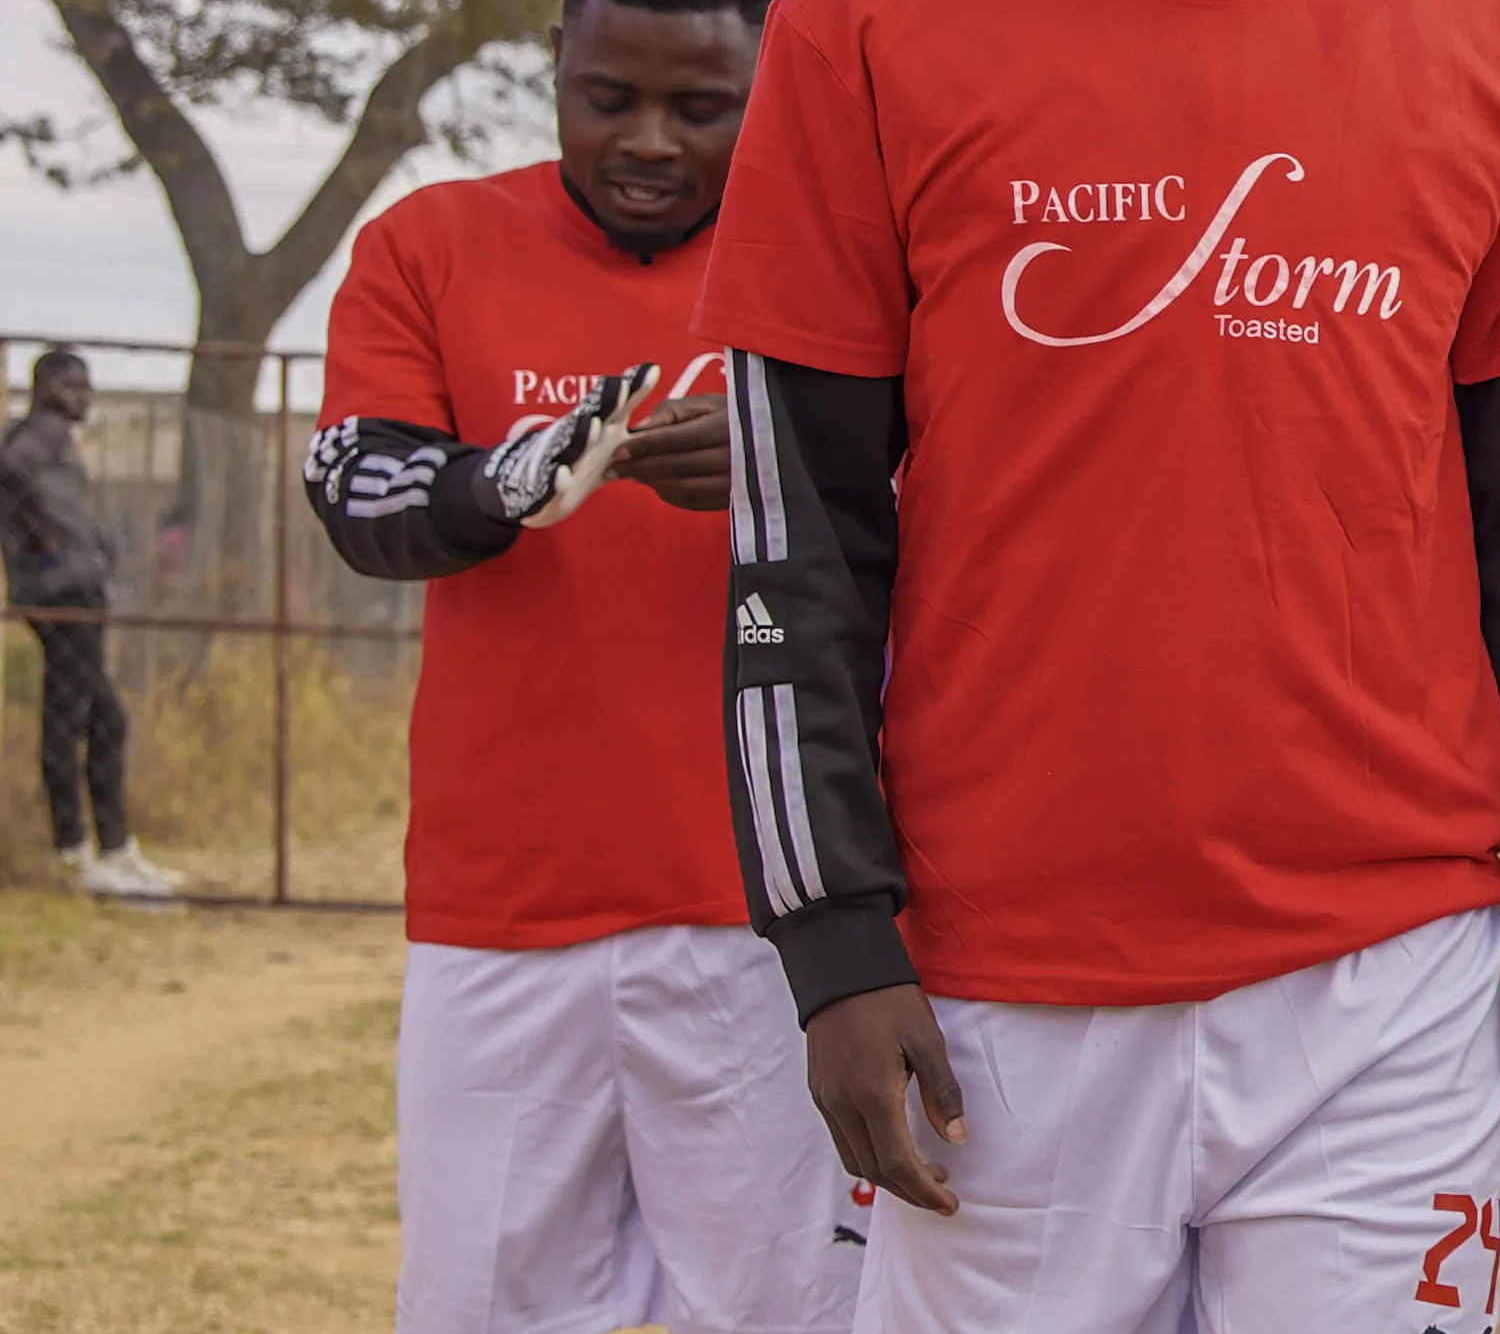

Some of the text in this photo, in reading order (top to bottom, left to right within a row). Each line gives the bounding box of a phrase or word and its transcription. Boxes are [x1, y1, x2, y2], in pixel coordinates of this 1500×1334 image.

[1009, 175, 1186, 224] PACIFIC
[1001, 152, 1403, 347] Storm
[1213, 314, 1319, 344] Toasted
[513, 369, 605, 405] PACI
[737, 624, 785, 645] idas
